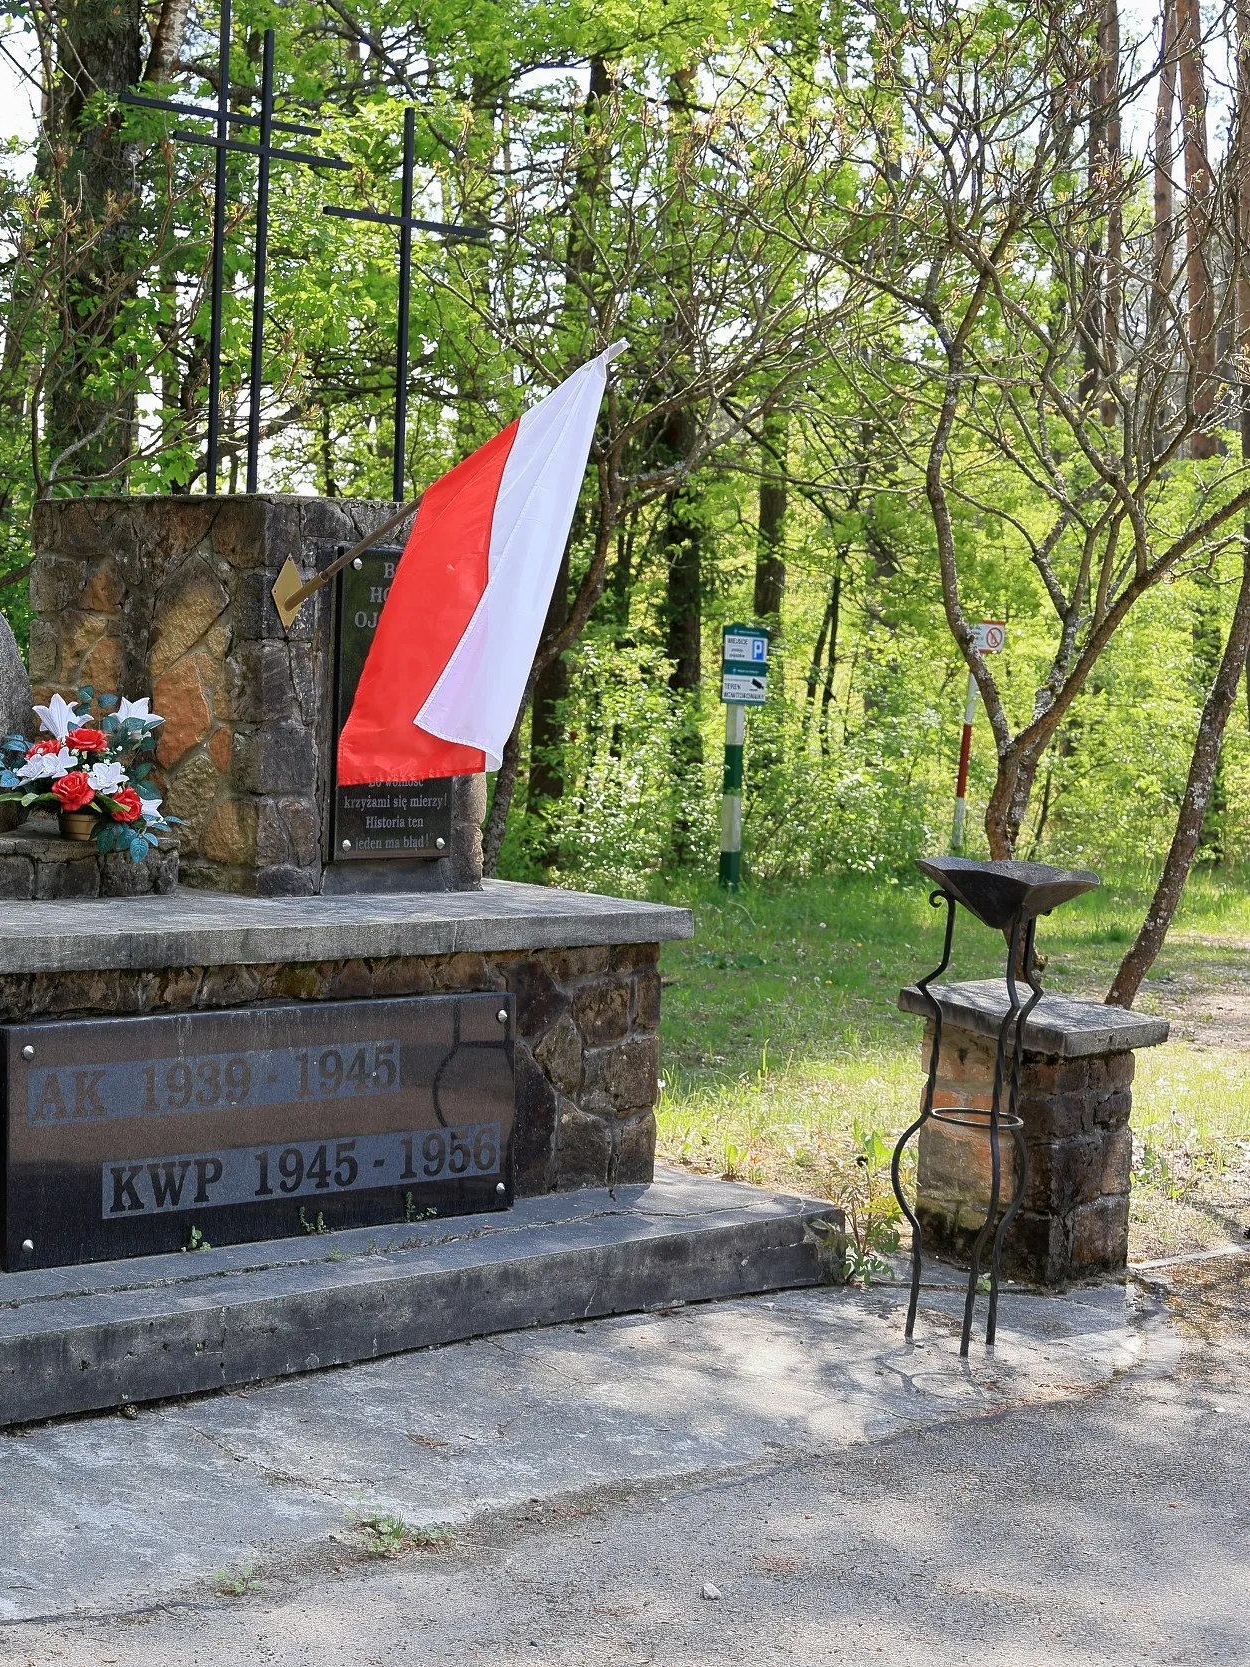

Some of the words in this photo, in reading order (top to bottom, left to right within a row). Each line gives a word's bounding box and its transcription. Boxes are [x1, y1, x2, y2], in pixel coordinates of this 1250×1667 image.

[343, 794, 391, 811] krzyżami
[393, 795, 408, 810] się
[410, 793, 447, 811] mierzy!
[365, 815, 406, 829] Historia
[408, 816, 424, 828] ten
[355, 836, 382, 852] jeden
[385, 841, 400, 850] ma
[31, 1069, 107, 1120] AK
[140, 1056, 251, 1111] 1939
[294, 1042, 398, 1097] 1945
[109, 1157, 223, 1213] KWP
[253, 1139, 359, 1197] 1945
[398, 1127, 496, 1180] 1956
